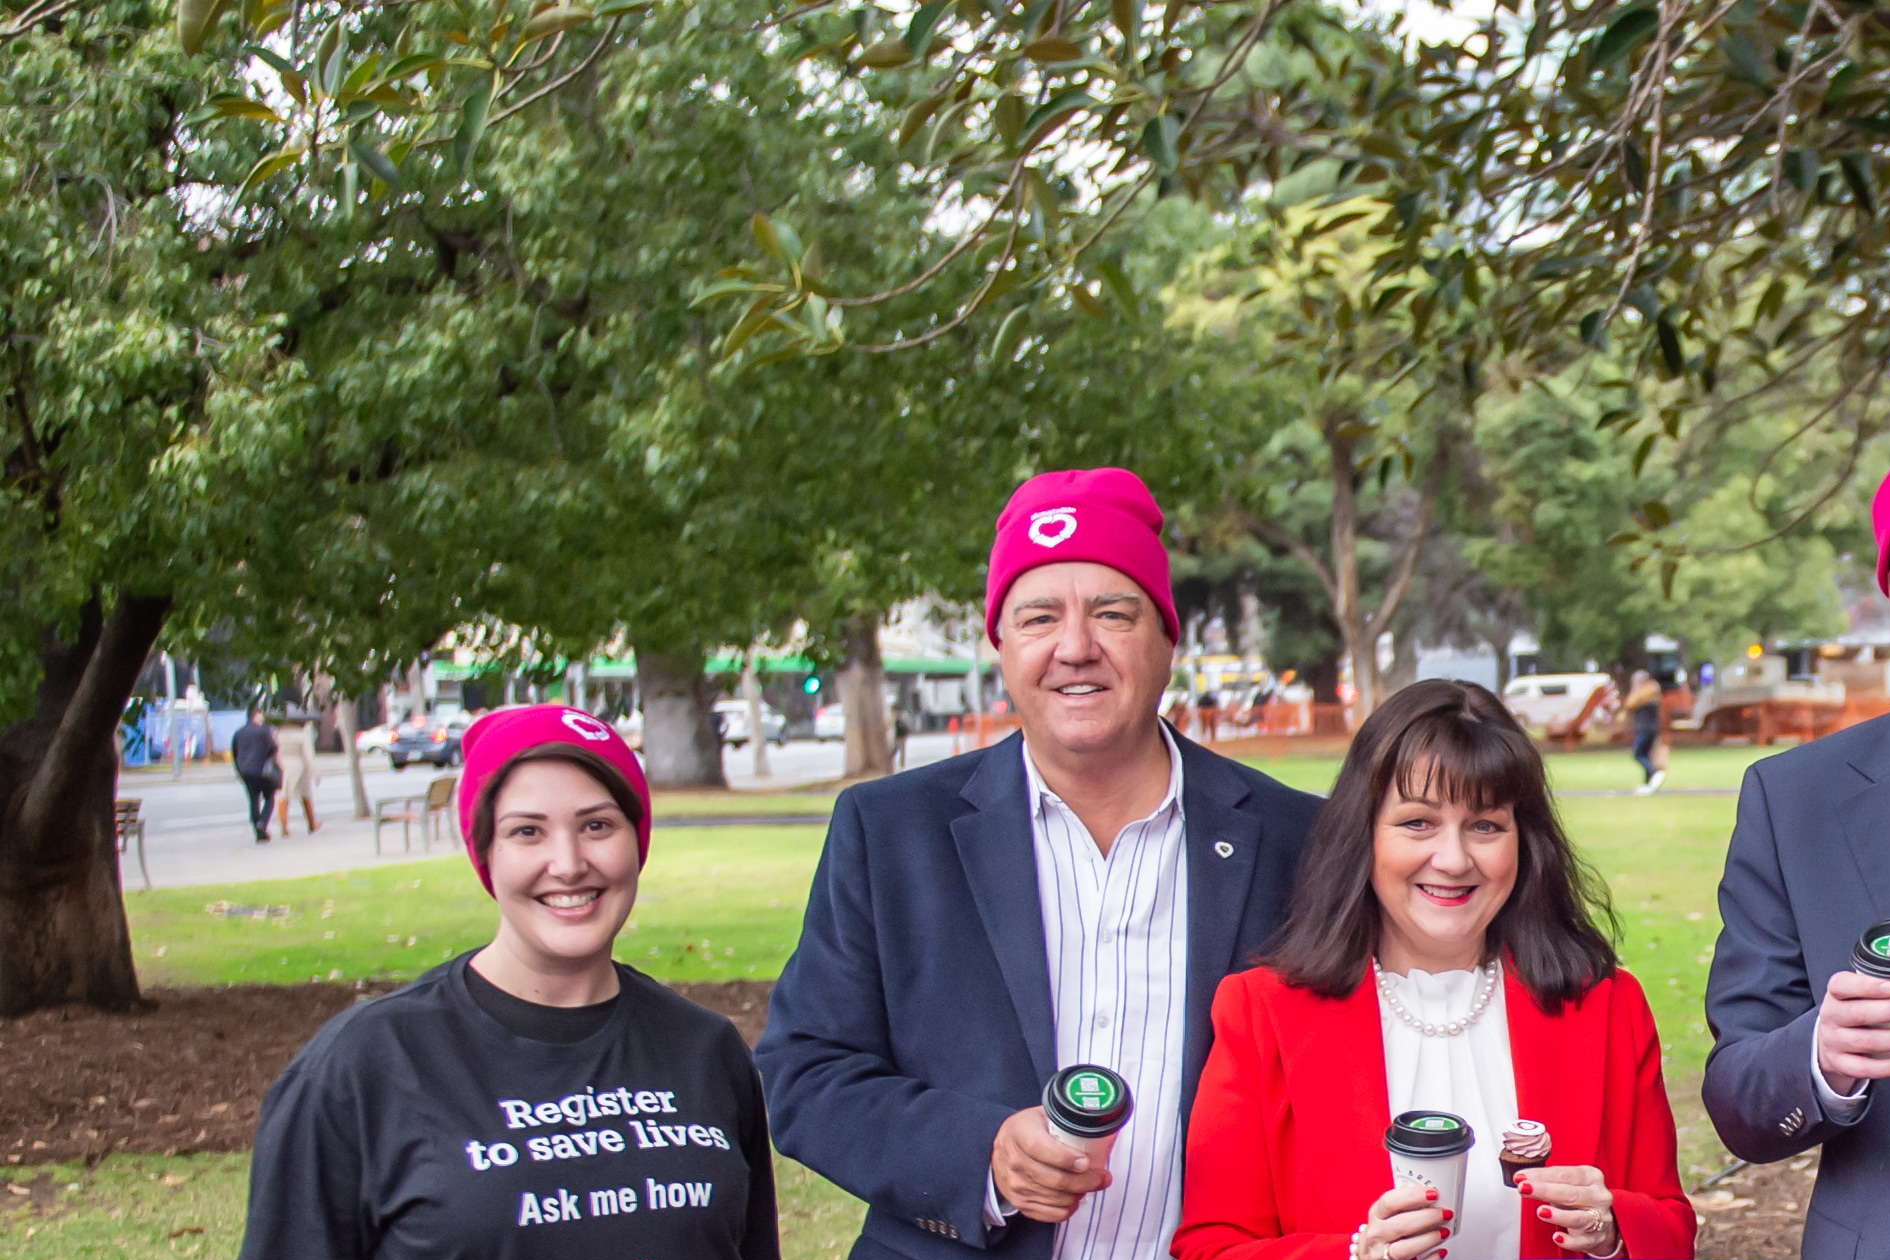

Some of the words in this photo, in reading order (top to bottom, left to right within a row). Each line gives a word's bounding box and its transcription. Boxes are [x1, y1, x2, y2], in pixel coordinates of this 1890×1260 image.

[499, 1085, 678, 1129] Register
[465, 1140, 519, 1171] to
[526, 1129, 625, 1161] save
[628, 1119, 731, 1150] lives
[518, 1188, 581, 1226] Ask
[590, 1186, 638, 1217] me
[645, 1178, 713, 1209] how
